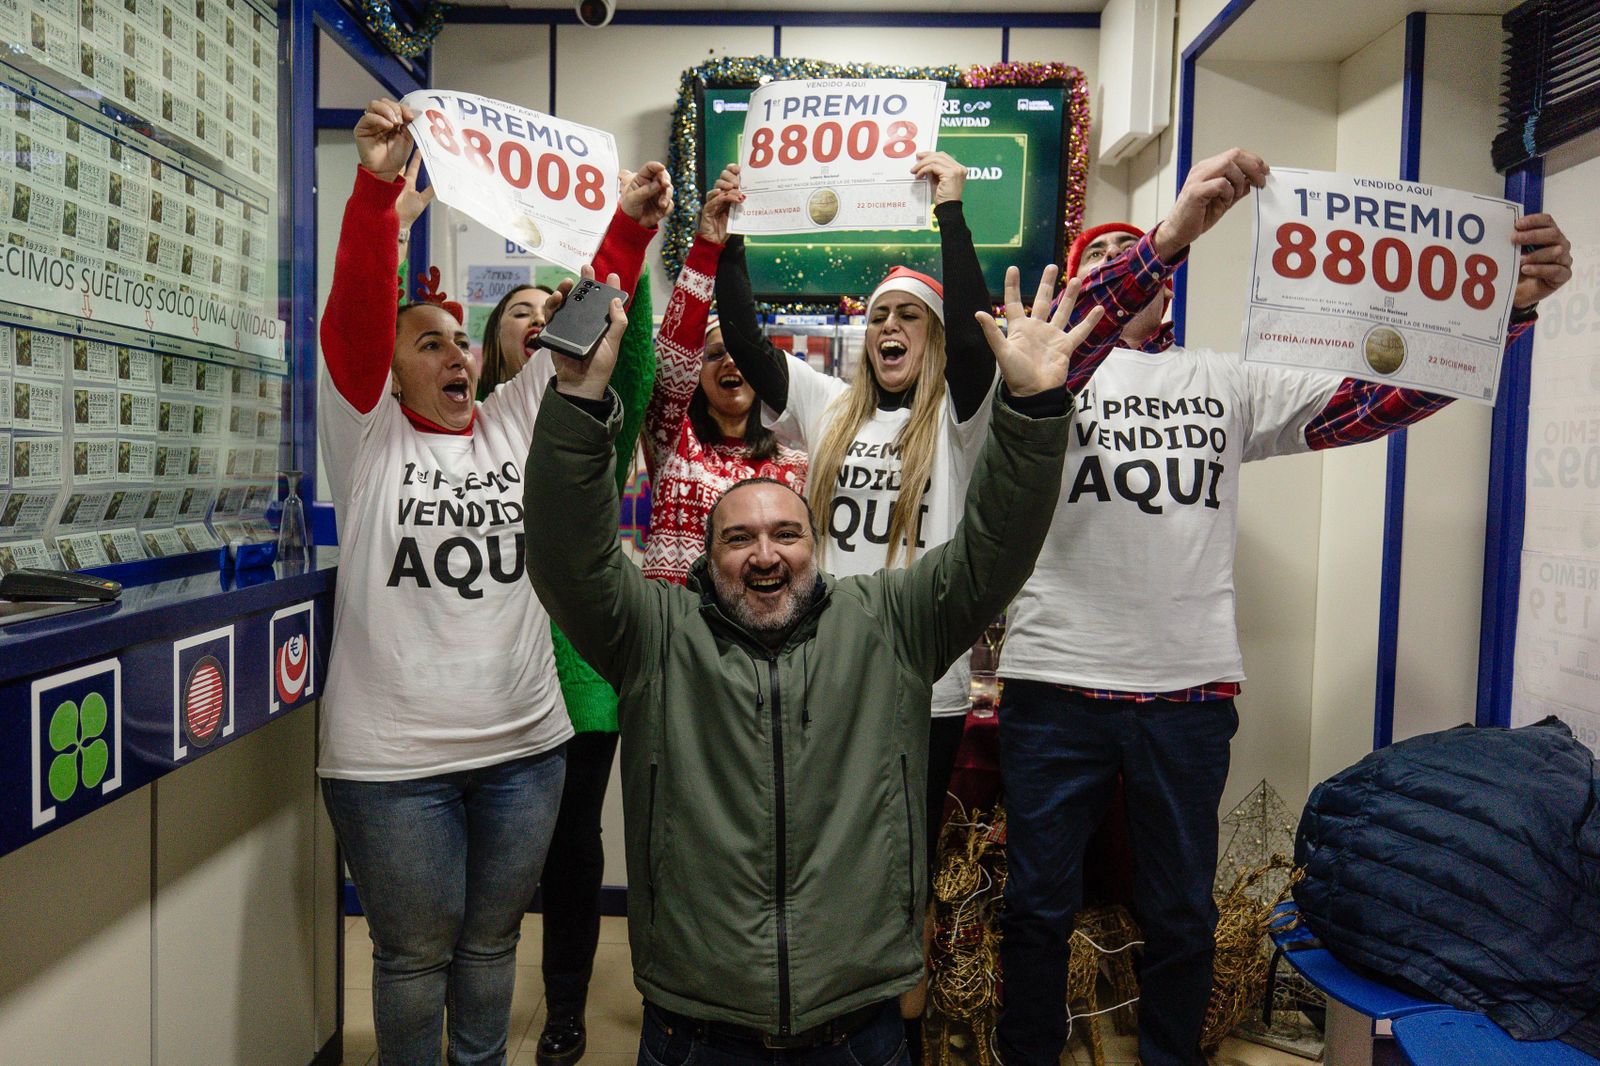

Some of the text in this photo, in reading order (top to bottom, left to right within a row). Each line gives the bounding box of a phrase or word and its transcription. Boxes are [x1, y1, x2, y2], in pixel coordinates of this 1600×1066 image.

[806, 81, 843, 89] VENDIDO
[783, 94, 908, 120] PREMIO
[456, 97, 590, 157] PREMIO
[941, 117, 990, 128] NAVIDAD
[748, 120, 918, 169] 88008
[425, 109, 607, 212] 88008
[1353, 178, 1434, 197] VENDIDO AQUÍ
[774, 206, 801, 214] NAVIDAD
[867, 201, 907, 209] DICIEMBRE
[1326, 192, 1486, 245] PREMIO
[1272, 222, 1499, 311] 88008
[81, 268, 154, 310] SUELTOS
[156, 286, 195, 318] SOLO
[199, 299, 227, 327] UNA
[231, 308, 277, 339] UNIDAD
[1390, 317, 1402, 325] QUE
[1260, 332, 1299, 343] LOTERÍA
[1310, 337, 1355, 349] NAVIDAD
[1428, 355, 1477, 374] 22 DICIEMBRE
[1103, 395, 1225, 420] PREMIO
[1075, 420, 1227, 454] VENDIDO
[1068, 455, 1225, 515] AQUÍ
[398, 497, 523, 527] VENDID
[829, 496, 929, 552] QUI
[386, 533, 525, 599] AQU
